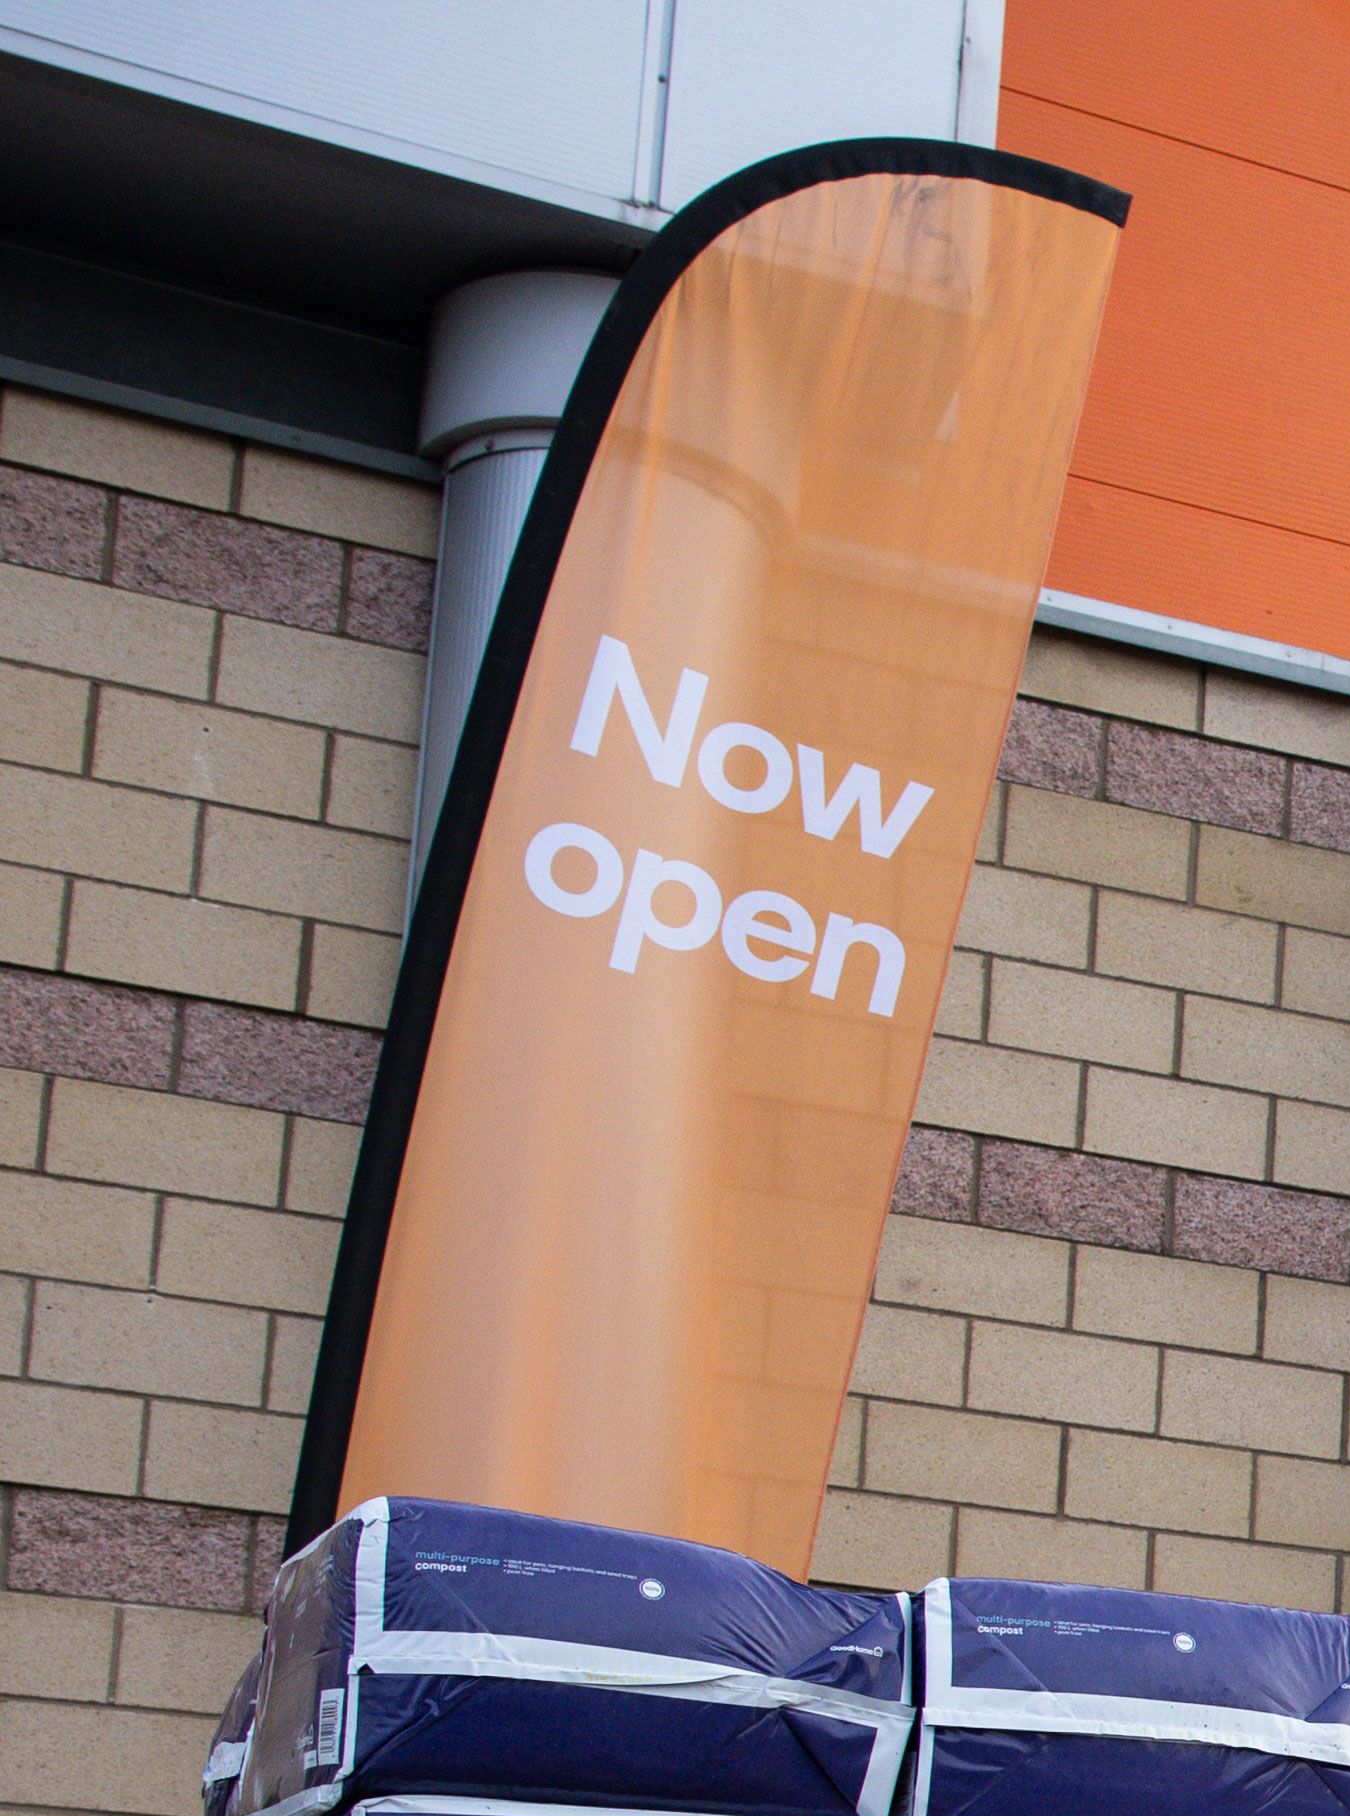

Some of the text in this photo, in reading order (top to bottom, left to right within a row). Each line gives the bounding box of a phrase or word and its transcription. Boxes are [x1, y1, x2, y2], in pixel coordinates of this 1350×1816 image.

[570, 634, 935, 859] Now
[524, 821, 906, 1017] open
[415, 1550, 500, 1566] multi-purpose
[415, 1561, 467, 1574] compost
